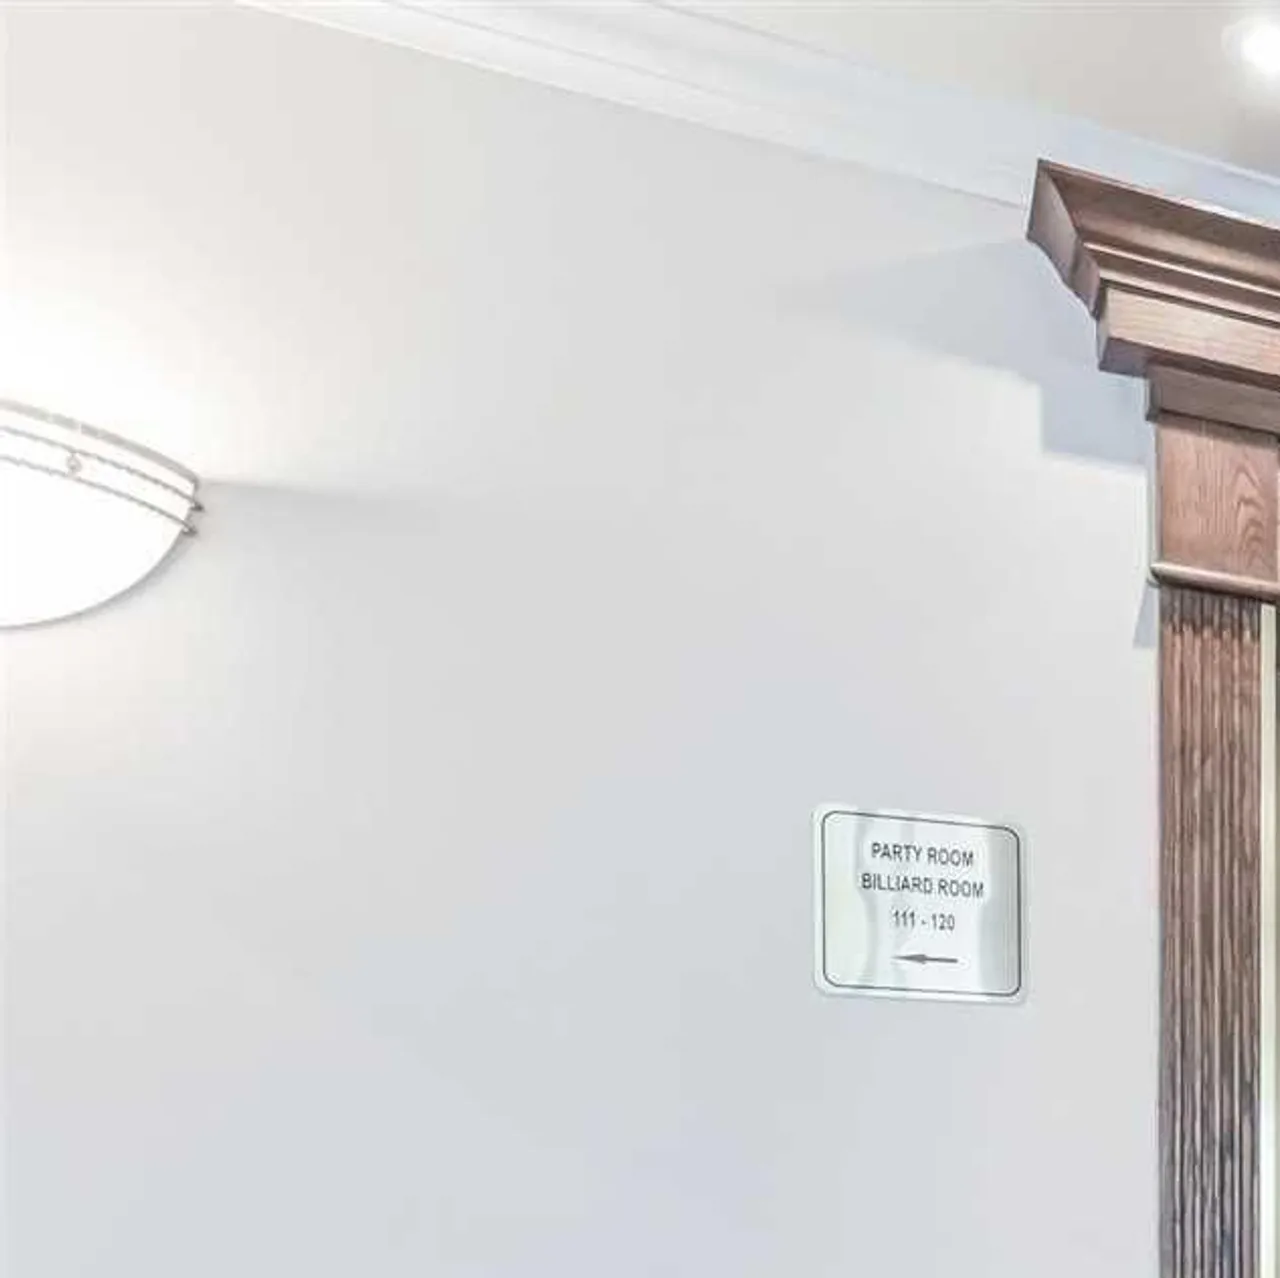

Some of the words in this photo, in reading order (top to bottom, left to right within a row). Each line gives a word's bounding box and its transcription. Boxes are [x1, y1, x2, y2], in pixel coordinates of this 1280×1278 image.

[871, 842, 923, 862] PARTY
[927, 847, 973, 867] ROOM
[861, 872, 933, 895] BILLIARD
[937, 879, 984, 898] ROOM
[893, 910, 915, 929] 111
[931, 913, 956, 931] 120
